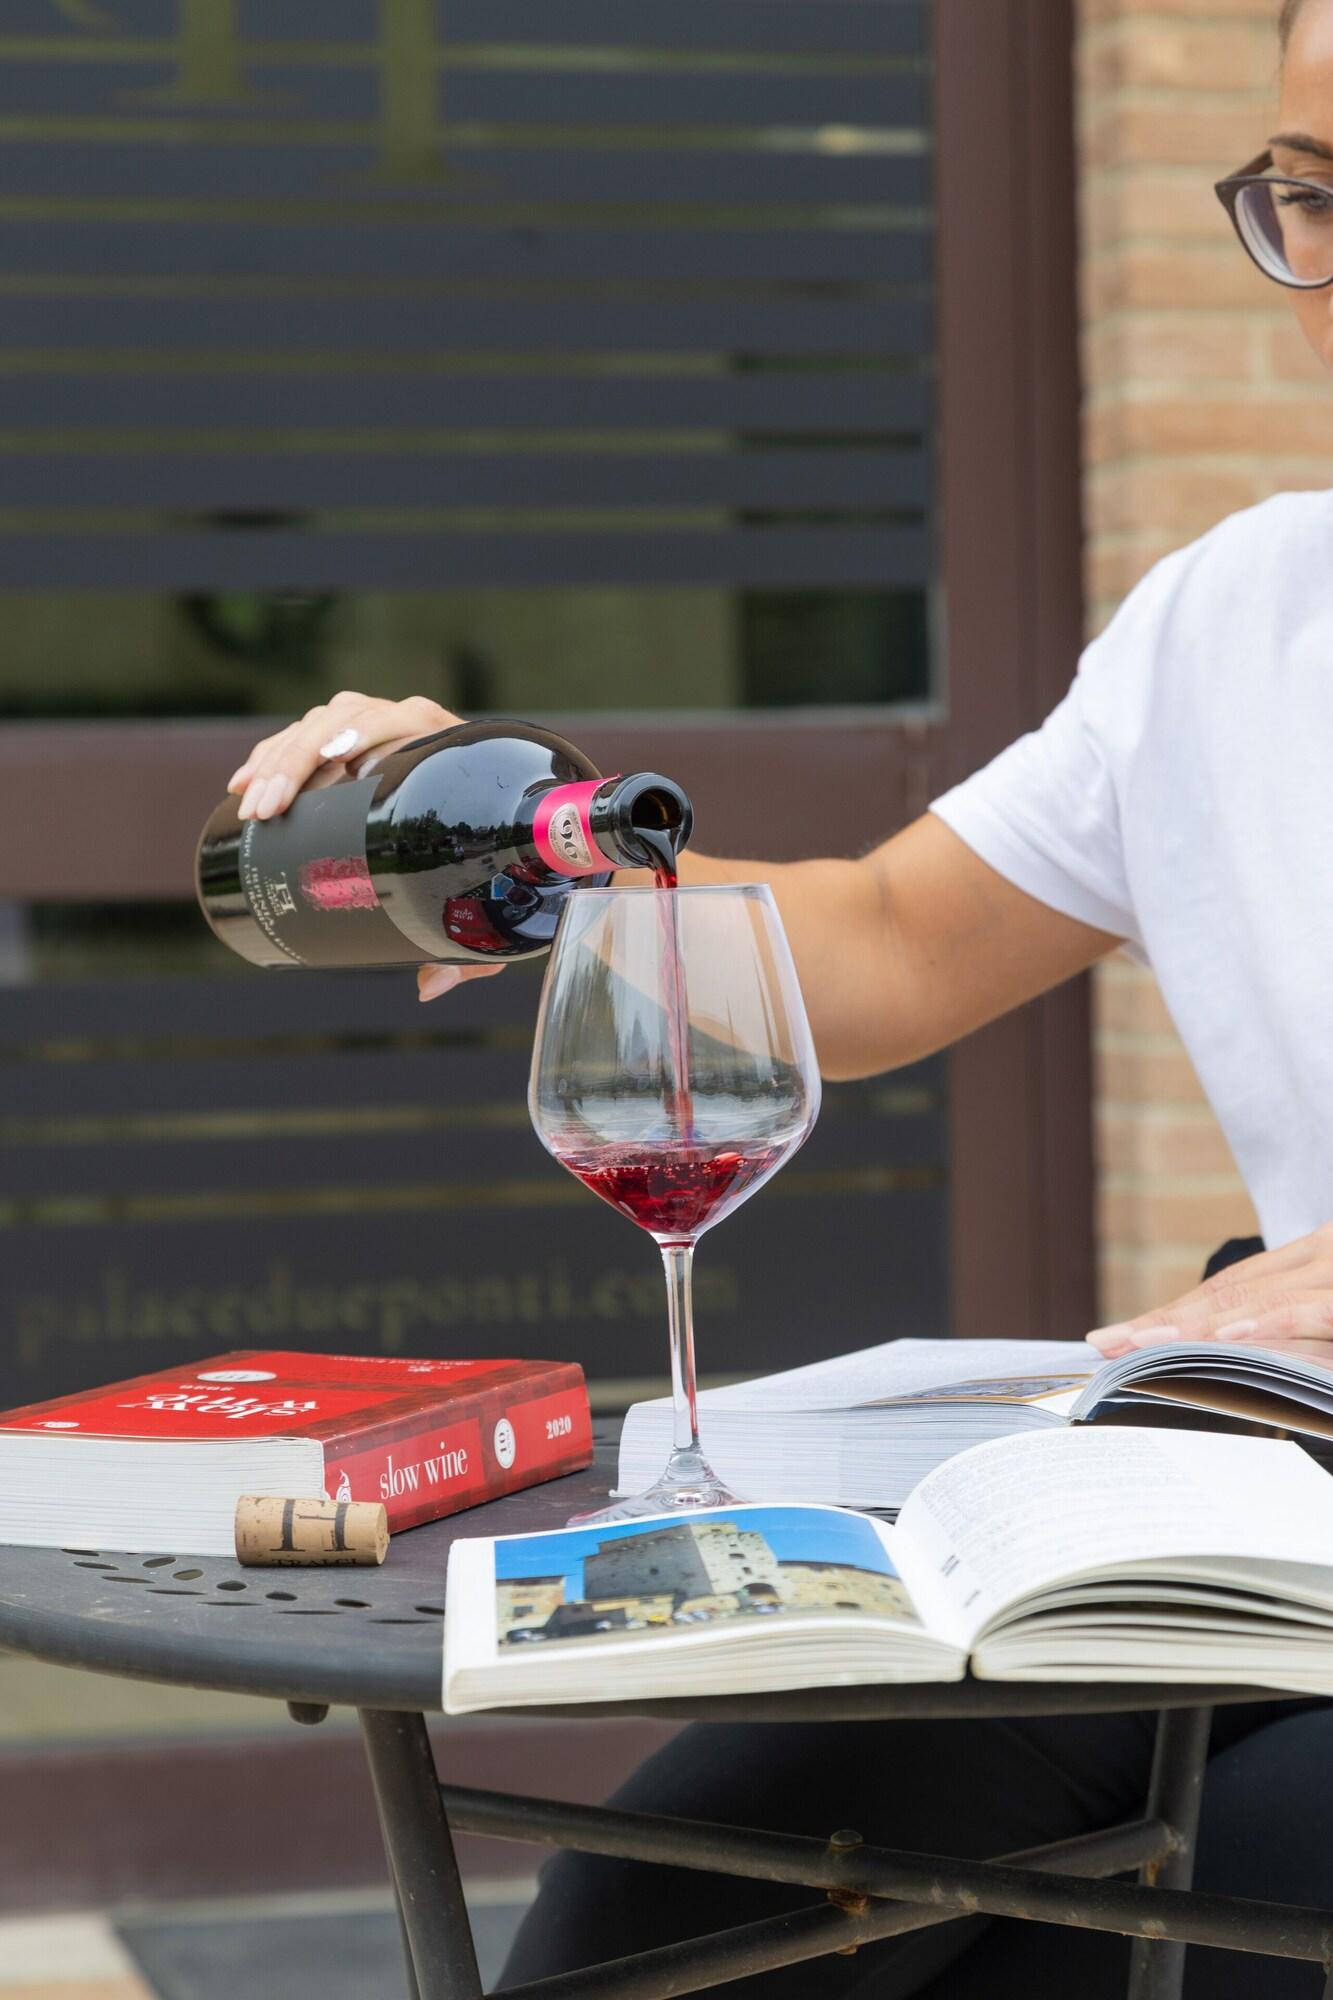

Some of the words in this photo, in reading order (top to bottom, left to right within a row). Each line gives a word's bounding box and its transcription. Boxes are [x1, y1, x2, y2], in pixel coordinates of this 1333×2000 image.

[545, 1415, 572, 1439] 2020
[379, 1455, 419, 1500] slow
[424, 1441, 469, 1486] wine
